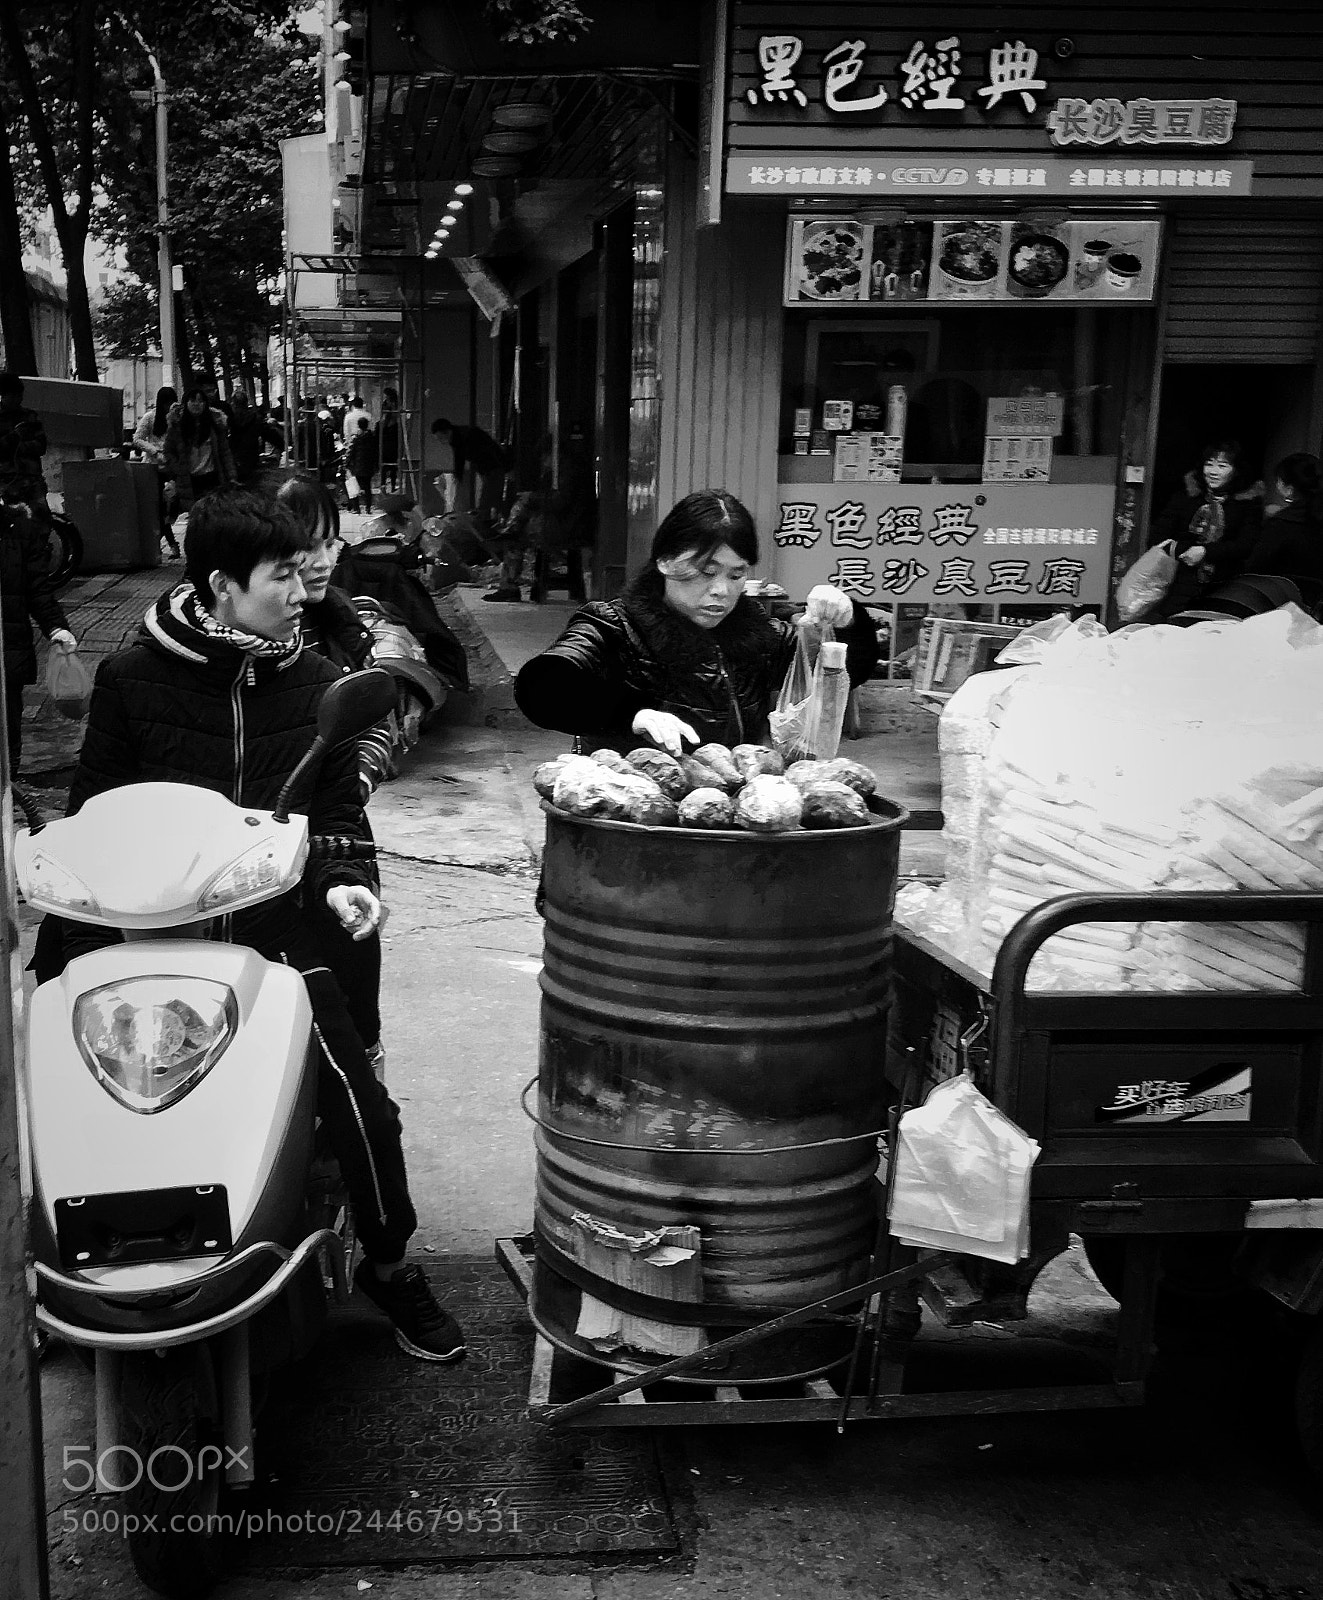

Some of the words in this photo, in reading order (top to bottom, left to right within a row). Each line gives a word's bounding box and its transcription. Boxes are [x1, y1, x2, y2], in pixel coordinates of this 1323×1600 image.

[747, 36, 1047, 113] 黑色經典
[1058, 104, 1231, 139] 长沙臭豆腐
[773, 500, 979, 550] 黑色經典
[828, 557, 1086, 597] 長沙臭豆腐
[1113, 1080, 1191, 1106] 买好车
